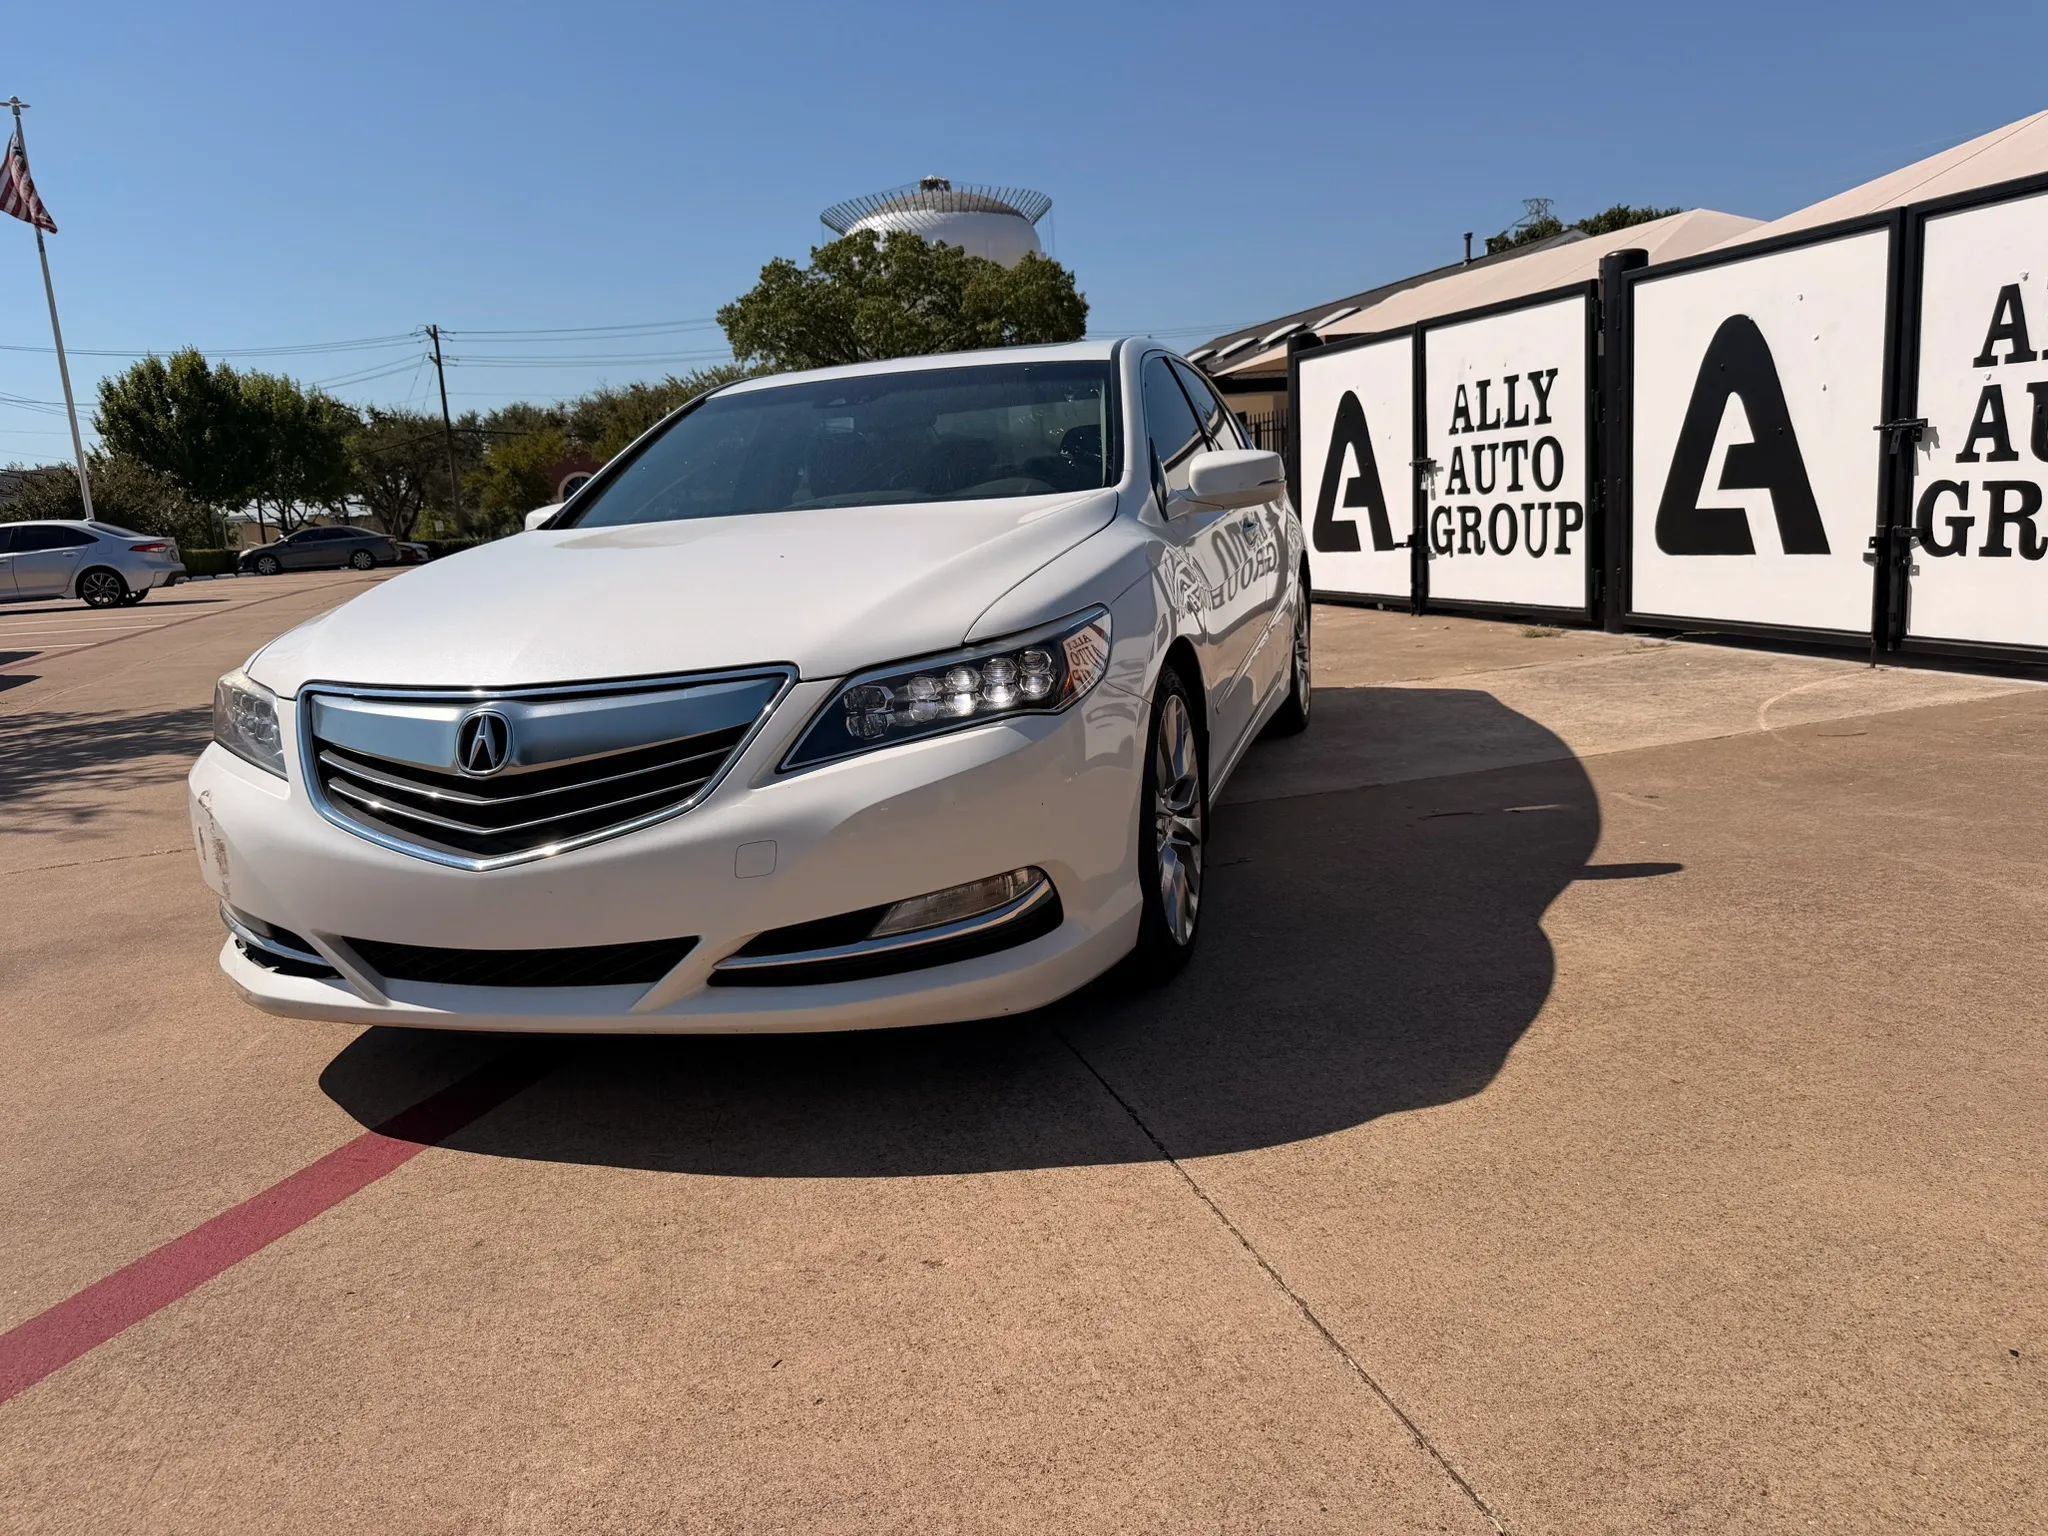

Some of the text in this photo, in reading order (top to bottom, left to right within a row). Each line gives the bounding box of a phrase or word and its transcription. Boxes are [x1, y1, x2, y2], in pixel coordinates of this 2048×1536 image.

[1972, 282, 2048, 368] A
[1448, 367, 1559, 436] ALLY
[1445, 435, 1564, 496] AUTO
[1430, 501, 1584, 559] GROUP
